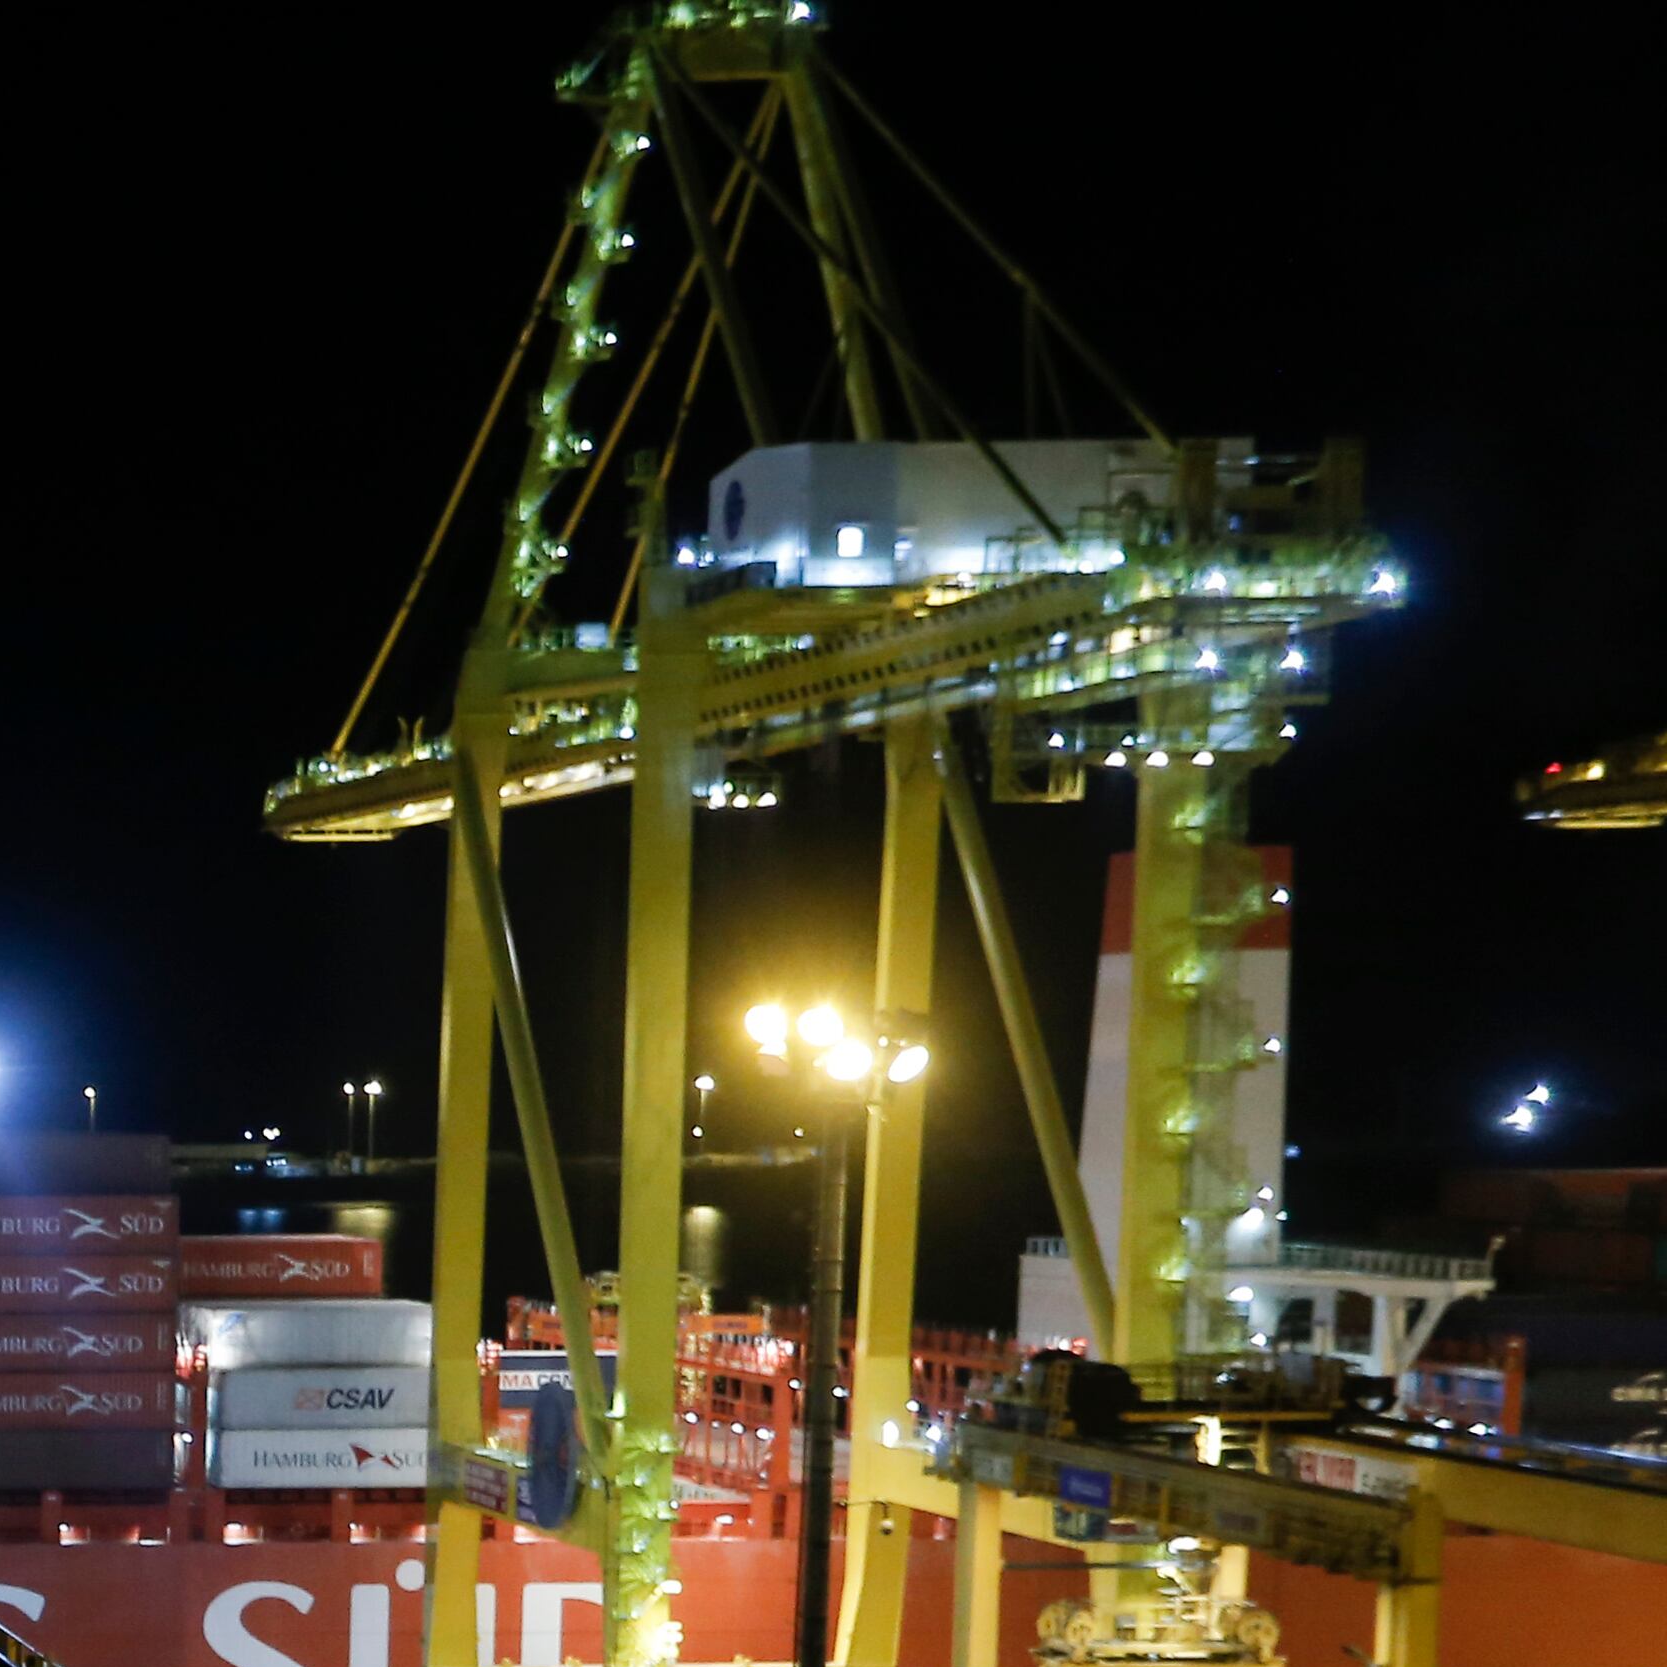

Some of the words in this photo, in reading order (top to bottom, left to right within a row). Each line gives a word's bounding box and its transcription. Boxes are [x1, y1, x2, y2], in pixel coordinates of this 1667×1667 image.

[182, 1260, 274, 1280] HAMBURG
[502, 1371, 535, 1388] MA
[326, 1387, 394, 1411] CSAV
[253, 1450, 351, 1467] HAMBURG
[391, 1447, 427, 1467] SÜ
